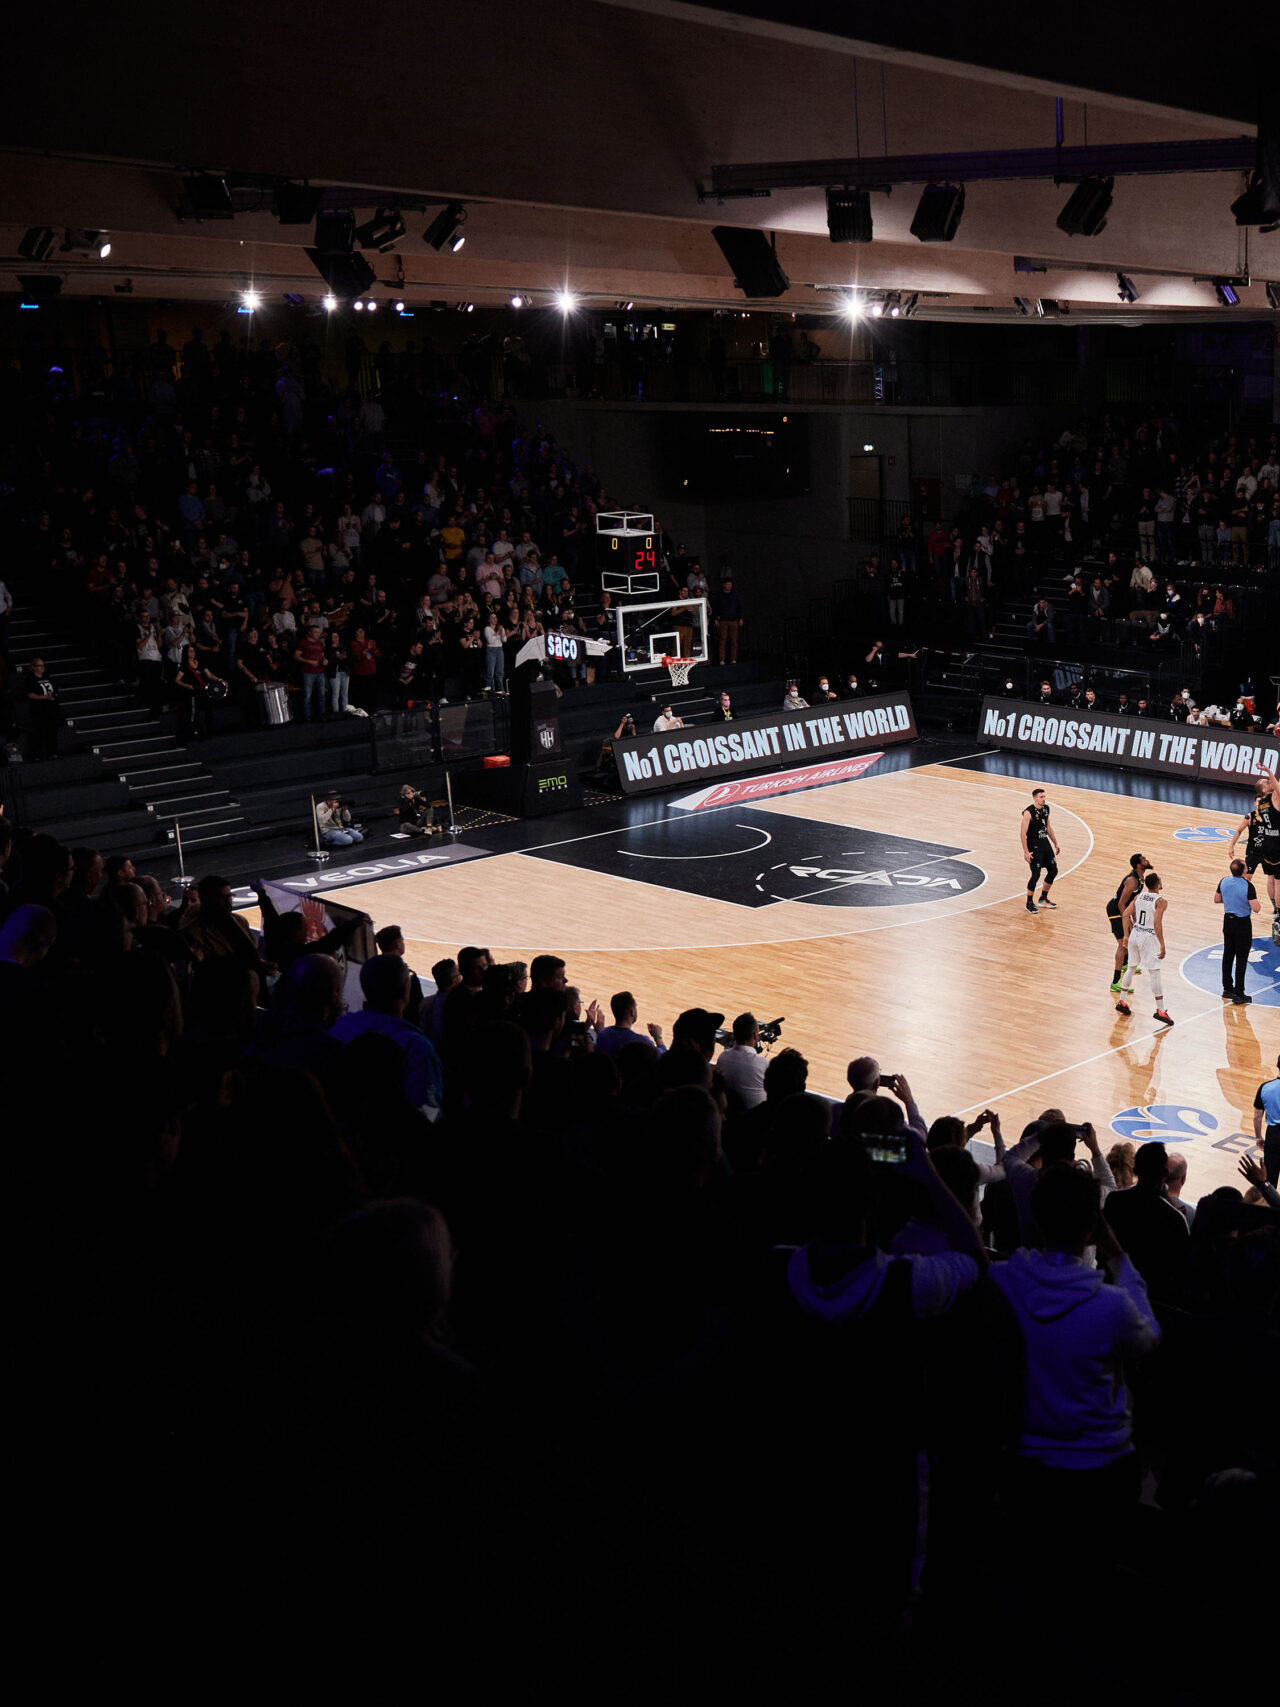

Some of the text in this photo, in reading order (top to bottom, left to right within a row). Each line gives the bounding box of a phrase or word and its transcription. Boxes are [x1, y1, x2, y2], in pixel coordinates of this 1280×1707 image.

[611, 537, 619, 550] 0
[645, 537, 653, 549] 0
[634, 551, 656, 570] 24
[547, 634, 578, 661] saco
[623, 704, 910, 782] No1 CROISSANT IN THE WORLD
[983, 709, 1280, 777] No1 CROISSANT IN THE WORLD
[740, 760, 875, 796] TURKISH AIRLINES
[283, 852, 451, 888] VEOLIA
